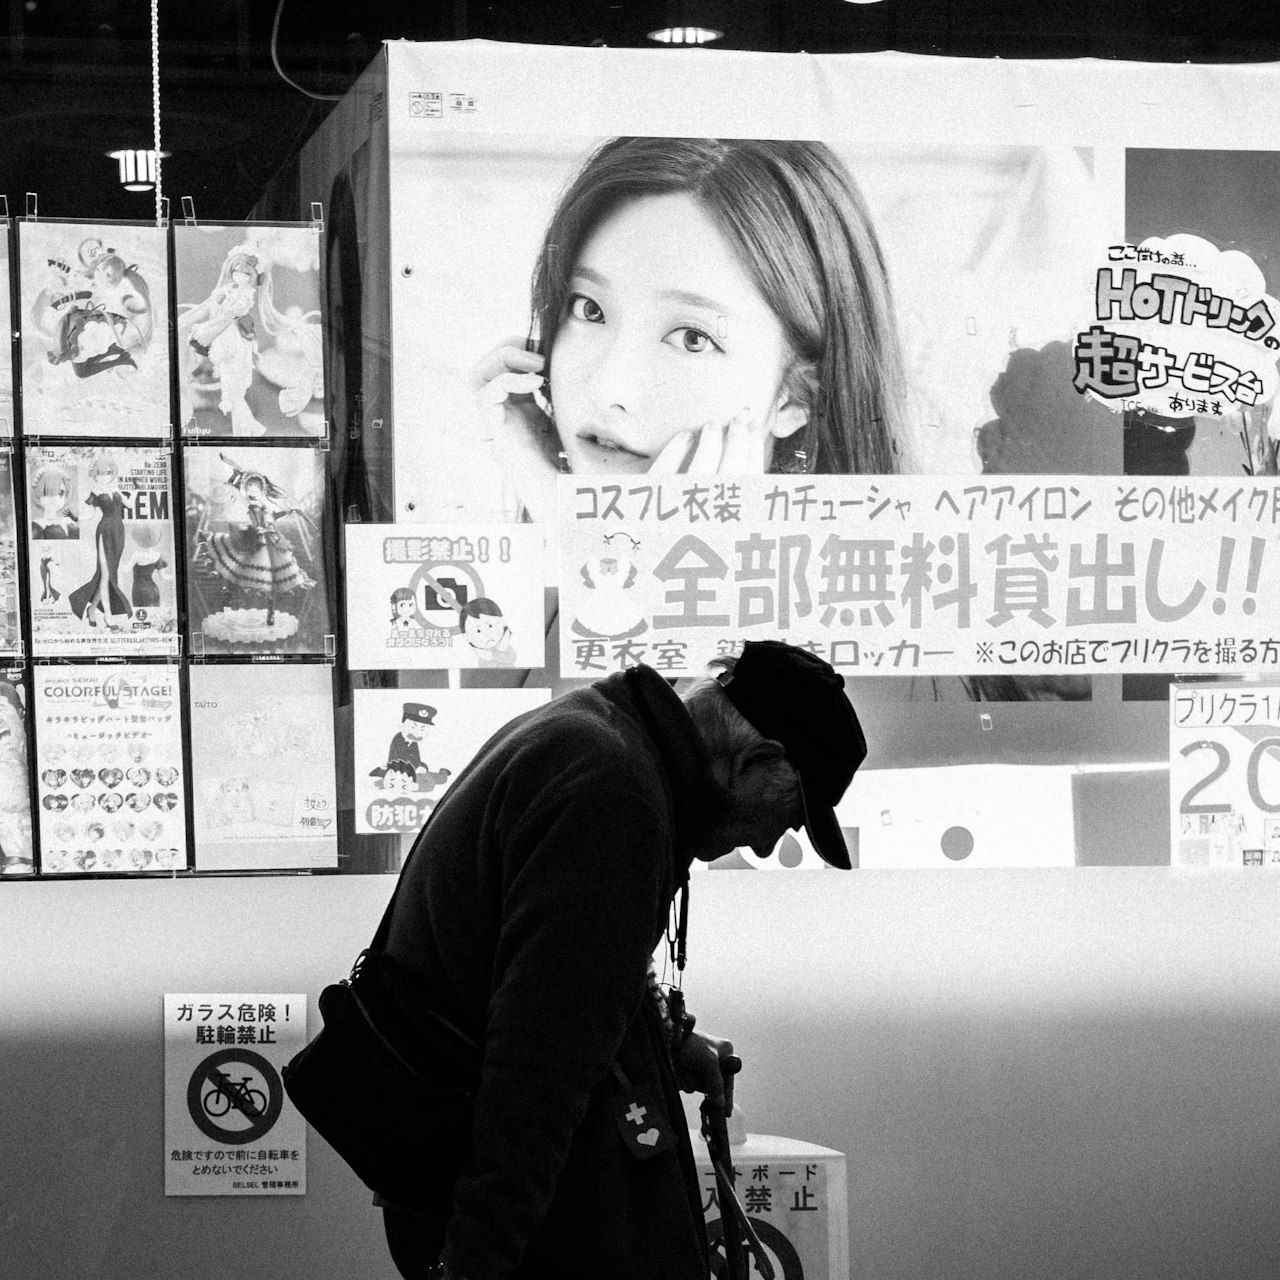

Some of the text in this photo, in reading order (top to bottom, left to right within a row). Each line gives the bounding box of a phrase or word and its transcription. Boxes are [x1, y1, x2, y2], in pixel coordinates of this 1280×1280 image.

[765, 484, 912, 522] カチューシャ
[934, 485, 1093, 522] ヘアアイロン
[652, 532, 1267, 630] 全部無料貸出し!!
[571, 638, 688, 671] 更衣室
[44, 685, 172, 697] COLORFUL STAGE!
[196, 1025, 277, 1045] 駐輪禁止
[171, 1150, 300, 1162] 危険ですので前に自転車を
[192, 1164, 279, 1176] とめないでください
[232, 1180, 260, 1189] BELSEL
